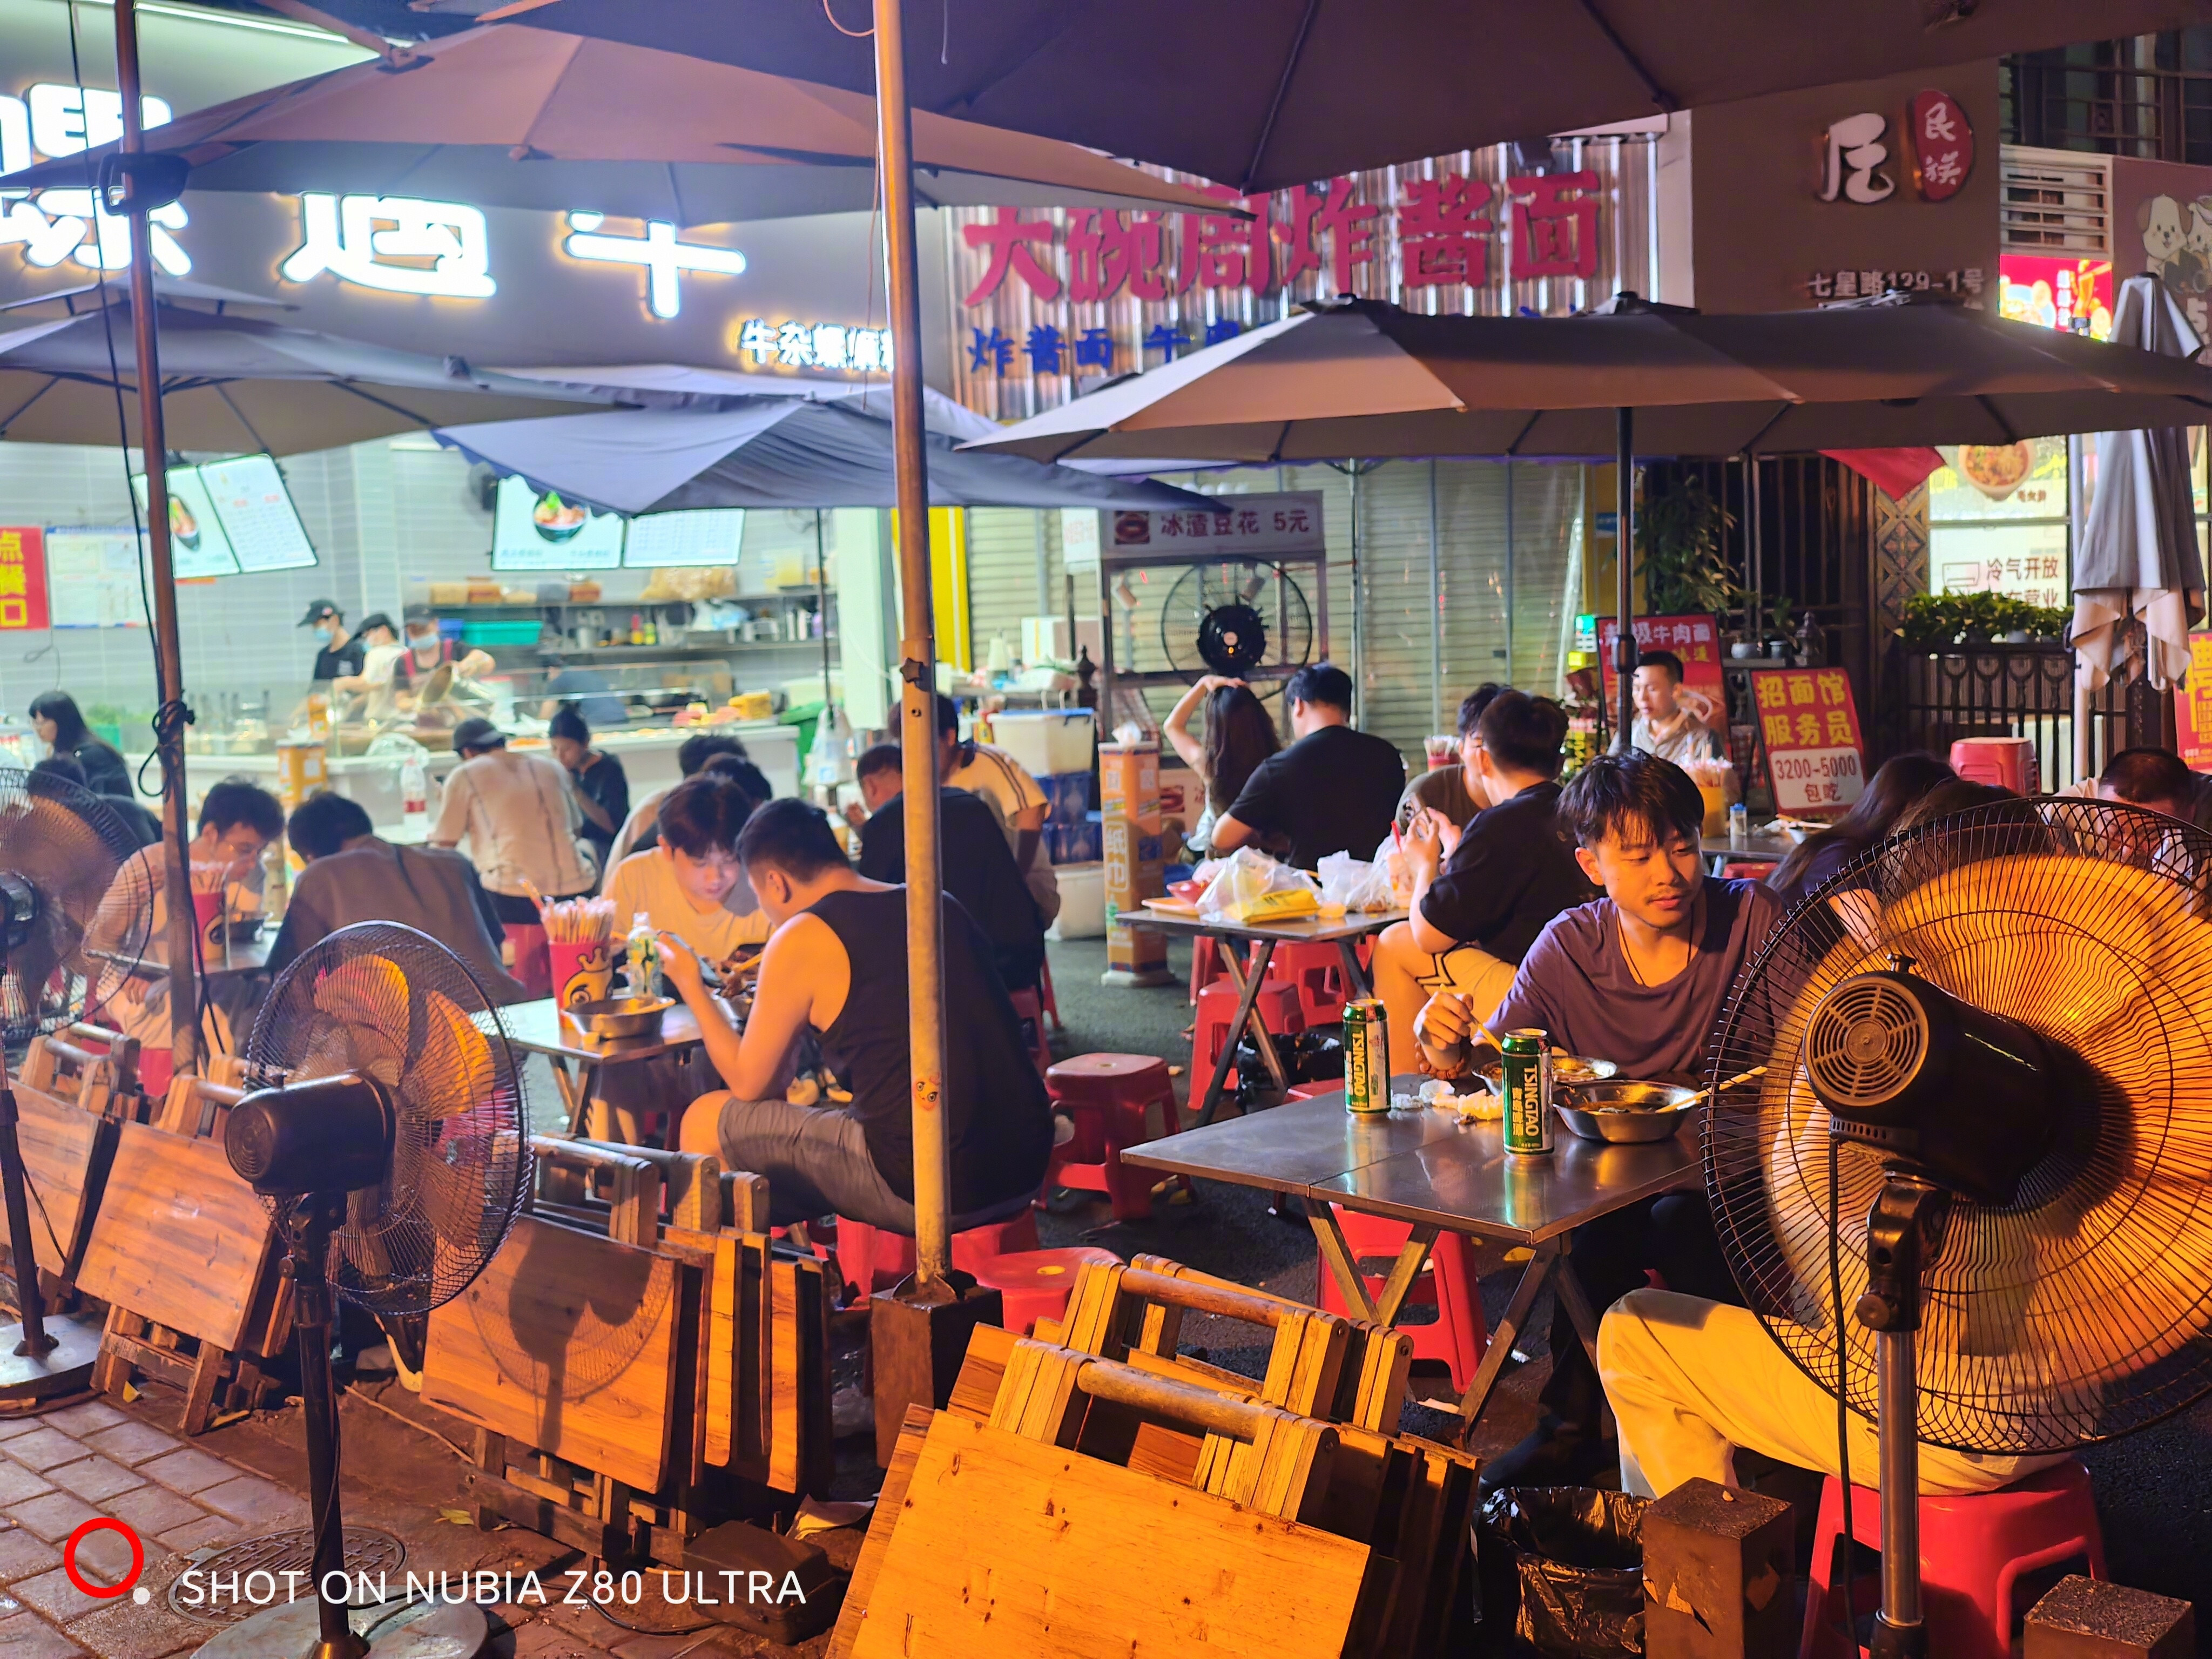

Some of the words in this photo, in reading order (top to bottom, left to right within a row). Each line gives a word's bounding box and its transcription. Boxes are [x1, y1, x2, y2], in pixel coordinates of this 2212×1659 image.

[967, 323, 1114, 377] 炸酱面
[1273, 509, 1310, 533] 5元
[1987, 558, 2059, 580] 冷气开放
[1757, 672, 1845, 709] 招面馆
[1763, 710, 1854, 746] 服务员
[1775, 755, 1857, 780] 3200-5000
[1805, 778, 1841, 802] 包吃
[1352, 1029, 1367, 1097] TSINGTAO
[1523, 1063, 1540, 1137] TSINGTAO
